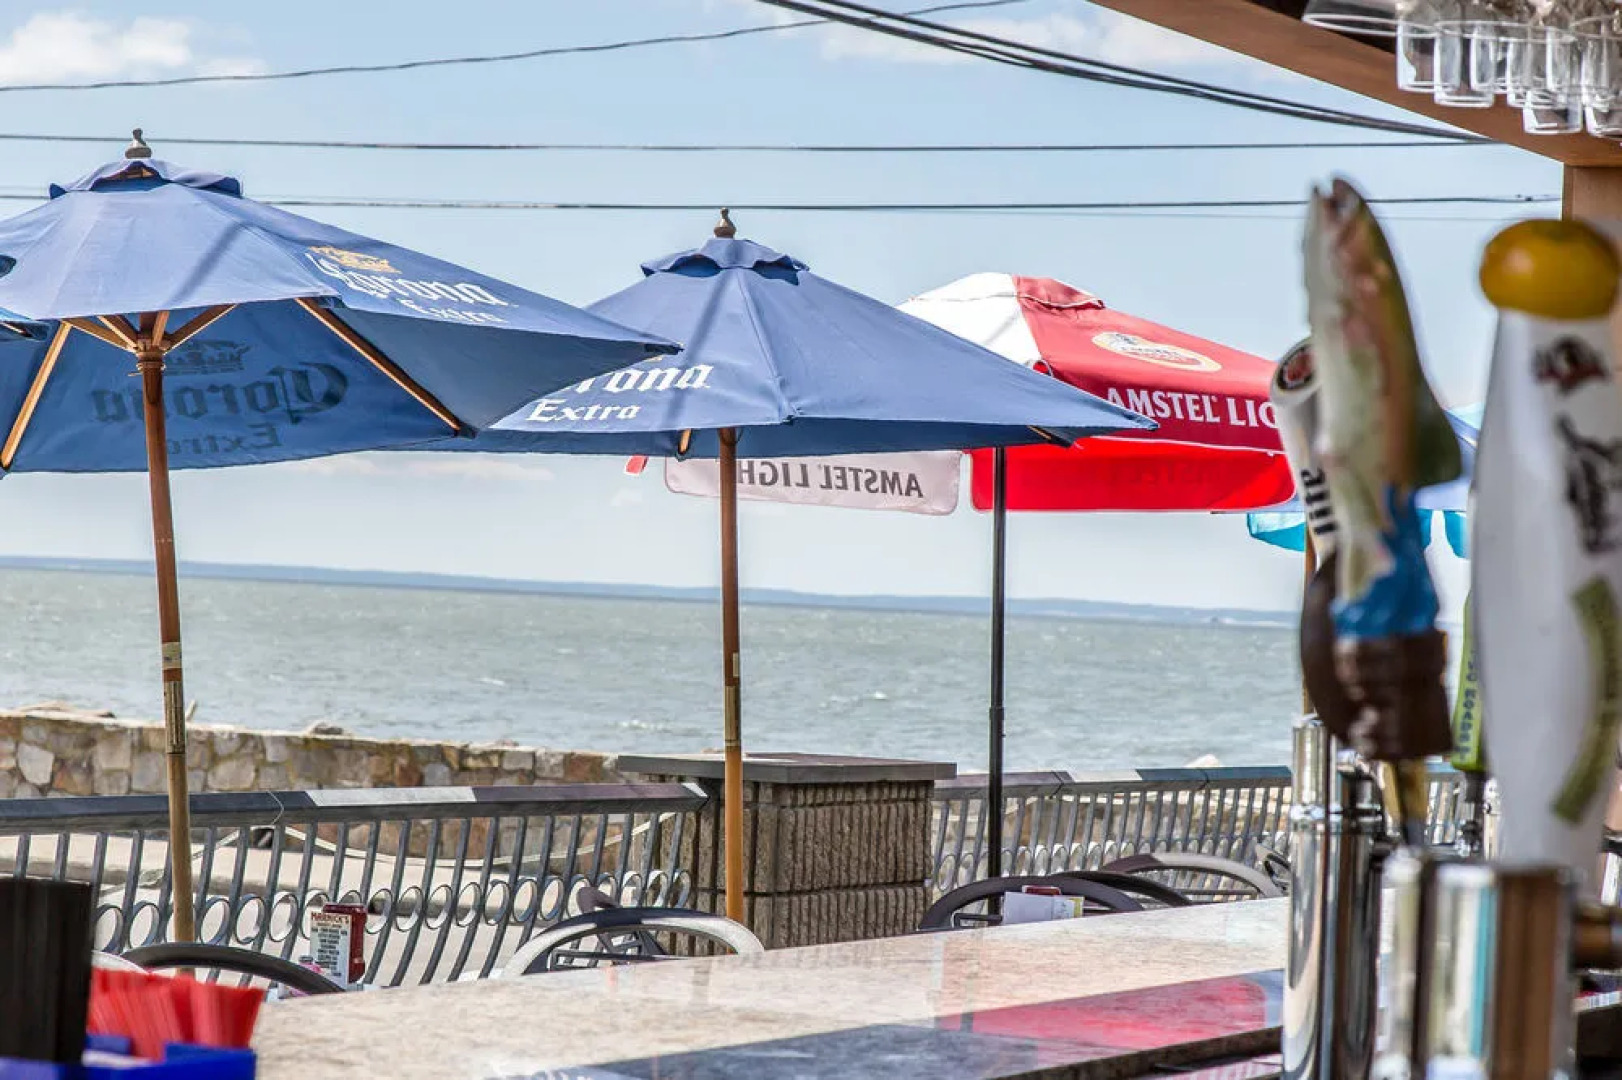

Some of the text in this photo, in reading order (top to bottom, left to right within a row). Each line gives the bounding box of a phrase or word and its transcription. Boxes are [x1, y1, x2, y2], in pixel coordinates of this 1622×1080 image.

[305, 252, 518, 308] Corona
[574, 364, 714, 394] rona
[525, 398, 642, 422] Extra
[1106, 387, 1221, 423] AMSTEL
